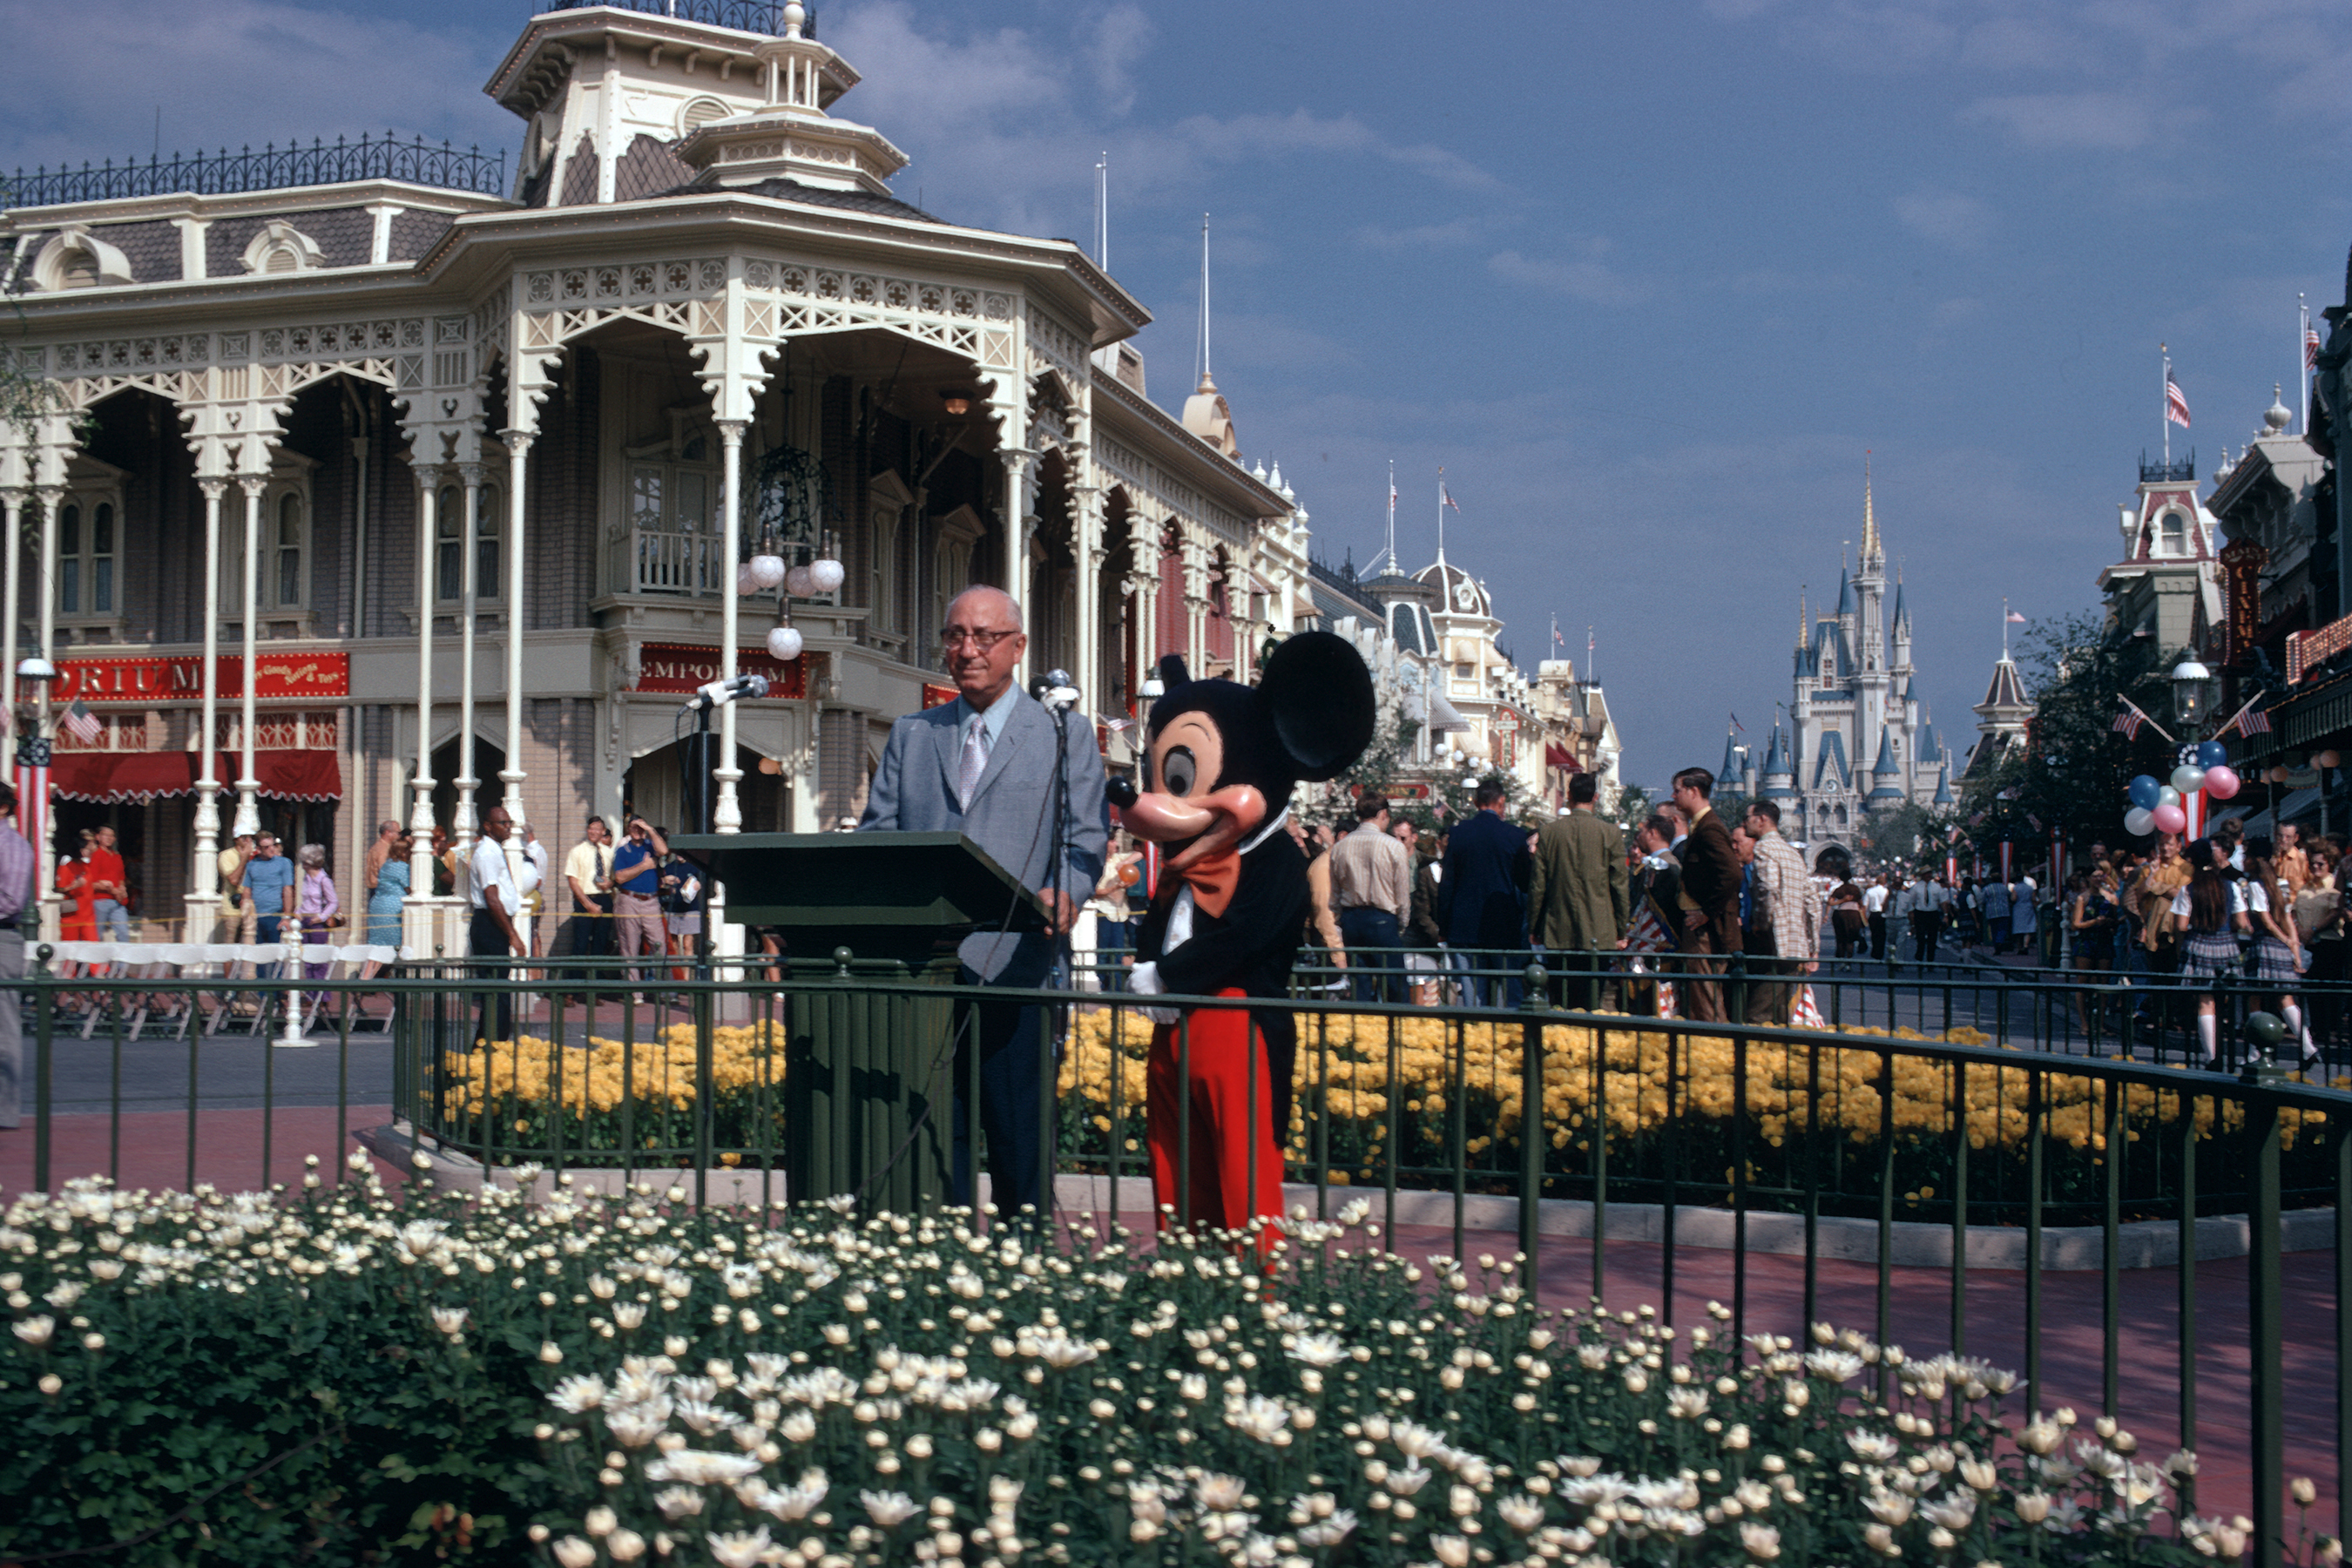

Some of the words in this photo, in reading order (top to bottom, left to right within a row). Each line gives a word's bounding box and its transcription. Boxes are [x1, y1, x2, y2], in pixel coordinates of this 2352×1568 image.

[54, 664, 201, 693] ORIUM
[284, 663, 317, 686] Notions
[306, 672, 314, 682] &
[317, 672, 339, 684] Toys
